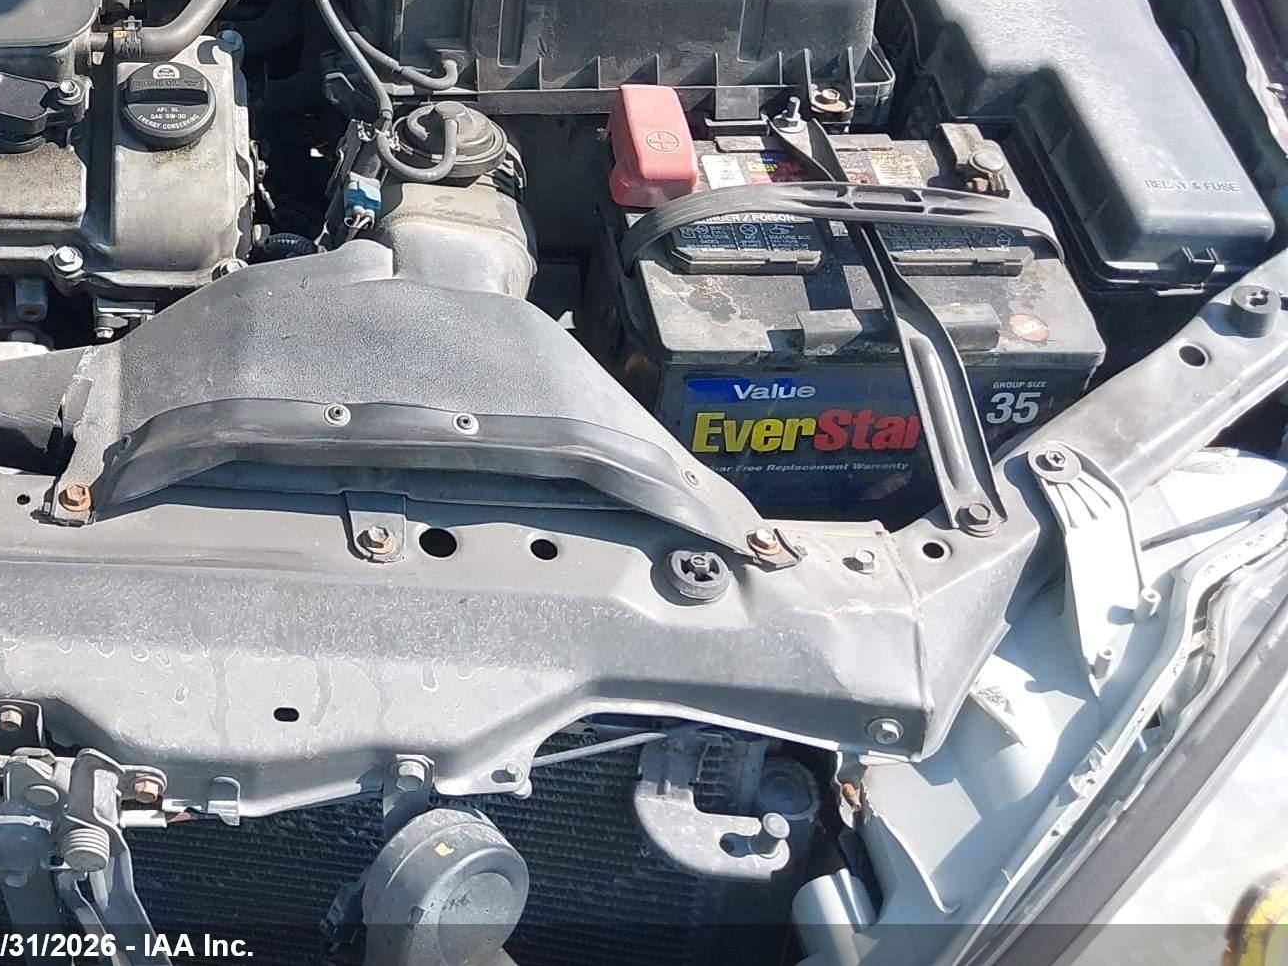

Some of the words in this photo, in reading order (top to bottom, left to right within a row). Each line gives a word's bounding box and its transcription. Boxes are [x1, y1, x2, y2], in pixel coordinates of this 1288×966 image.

[137, 114, 161, 129] ENERGY
[162, 114, 200, 130] CONSERVING
[1144, 179, 1187, 190] RELAY
[1205, 183, 1240, 192] FUSE
[750, 213, 796, 223] POISON
[733, 383, 817, 400] Value
[992, 381, 1025, 389] GROUP
[1026, 381, 1048, 389] SIZE
[986, 392, 1042, 424] 35
[766, 463, 849, 474] Replacement
[852, 462, 910, 472] Warranty
